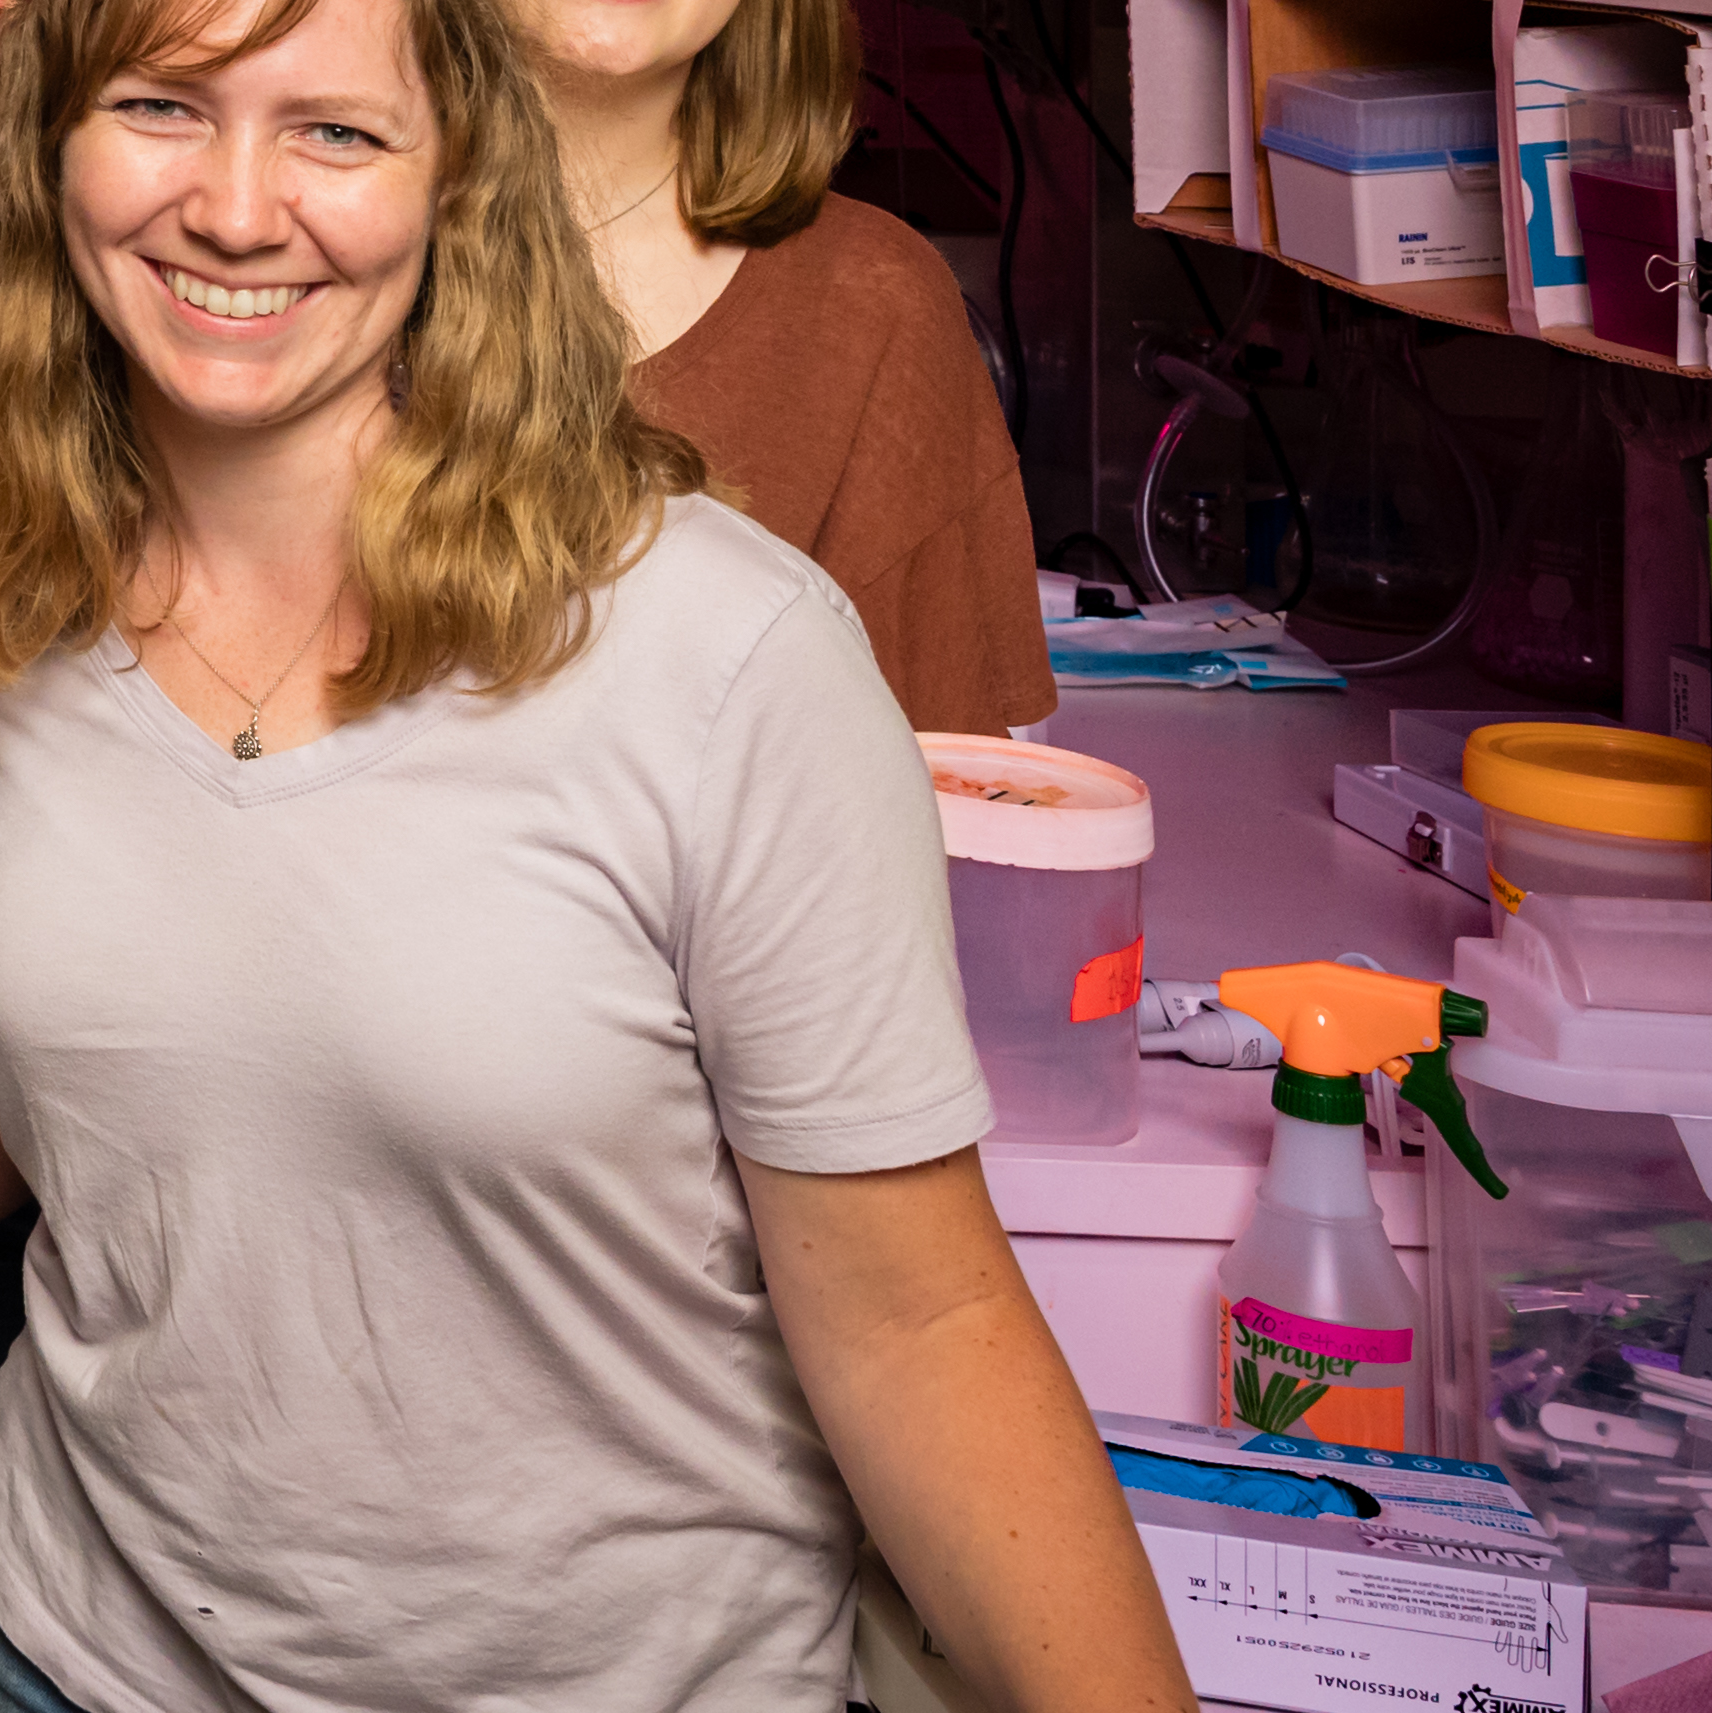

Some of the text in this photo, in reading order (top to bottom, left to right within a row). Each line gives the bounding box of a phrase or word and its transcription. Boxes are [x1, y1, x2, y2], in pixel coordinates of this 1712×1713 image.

[1398, 232, 1428, 243] RAININ
[1234, 1312, 1361, 1380] Sprayer
[1298, 1331, 1385, 1362] ethanol
[1452, 1518, 1532, 1534] NITRIL
[1361, 1535, 1552, 1572] AMMEX
[1188, 1576, 1207, 1588] XXL
[1218, 1580, 1231, 1592] XL
[1278, 1589, 1287, 1601] M
[1363, 1591, 1385, 1599] correct
[1397, 1595, 1410, 1603] find
[1335, 1595, 1365, 1607] TALLAS
[1366, 1600, 1378, 1609] DE
[1419, 1598, 1430, 1606] line
[1432, 1601, 1448, 1609] black
[1405, 1605, 1437, 1618] TAILLES
[1461, 1604, 1484, 1613] against
[1486, 1608, 1501, 1616] hand
[1439, 1610, 1456, 1620] DES
[1457, 1613, 1483, 1624] GUIDE
[1503, 1610, 1517, 1618] your
[1519, 1613, 1536, 1621] Place
[1490, 1618, 1516, 1629] GUIDE
[1518, 1622, 1536, 1632] SIZE
[1314, 1674, 1441, 1704] PROFESSIONAL
